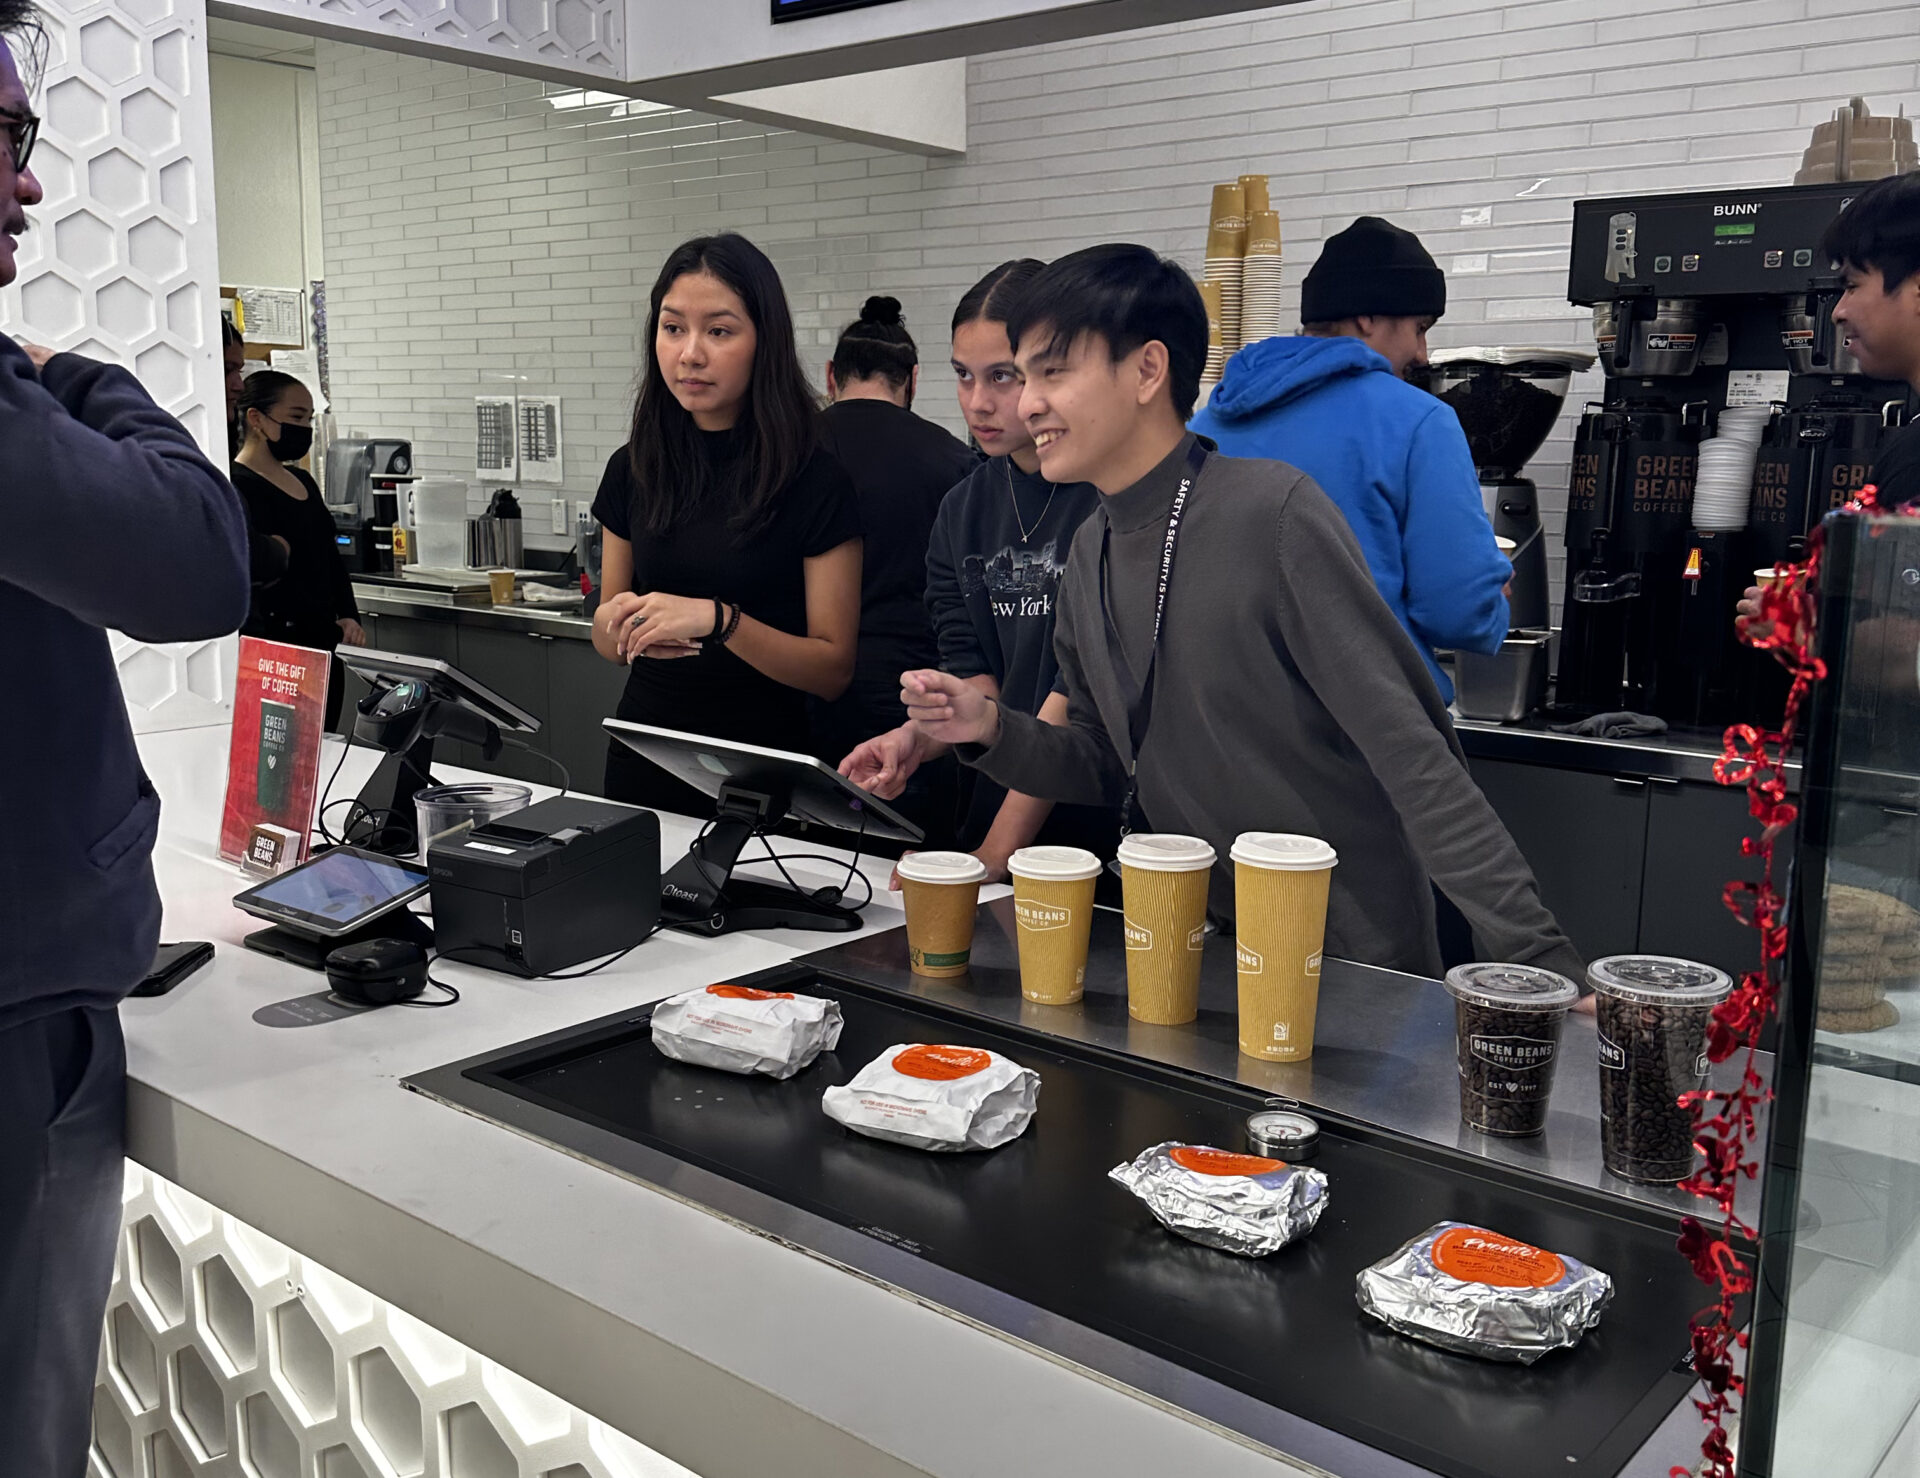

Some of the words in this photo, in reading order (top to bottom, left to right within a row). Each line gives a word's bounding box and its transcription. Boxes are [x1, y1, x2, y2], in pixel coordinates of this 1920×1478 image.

[1714, 204, 1757, 216] BUNN
[1573, 454, 1599, 475] EEN
[1636, 455, 1698, 476] GREE
[1757, 463, 1790, 485] EEN
[1634, 479, 1695, 499] BEAN
[1172, 478, 1190, 518] SAFETY
[1633, 502, 1684, 513] COFFEE
[1169, 518, 1178, 527] &
[1159, 528, 1176, 582] SECURITY
[1159, 583, 1167, 593] IS
[992, 602, 1016, 617] ew
[1020, 594, 1052, 616] York
[258, 658, 275, 674] GIVE
[276, 661, 289, 677] THE
[290, 665, 306, 680] GIFT
[262, 677, 272, 690] OF
[272, 679, 298, 697] COFFEE
[265, 714, 287, 731] GREEN
[264, 728, 286, 744] BEANS
[256, 836, 276, 851] GREEN
[253, 847, 273, 863] BEANS
[672, 887, 699, 902] toast
[1032, 910, 1066, 921] BEANS
[1474, 1040, 1512, 1056] GREEN
[1517, 1046, 1553, 1057] BEANS
[1599, 1042, 1620, 1061] EANS
[1494, 1055, 1523, 1064] COFFEE
[1488, 1081, 1503, 1089] EST
